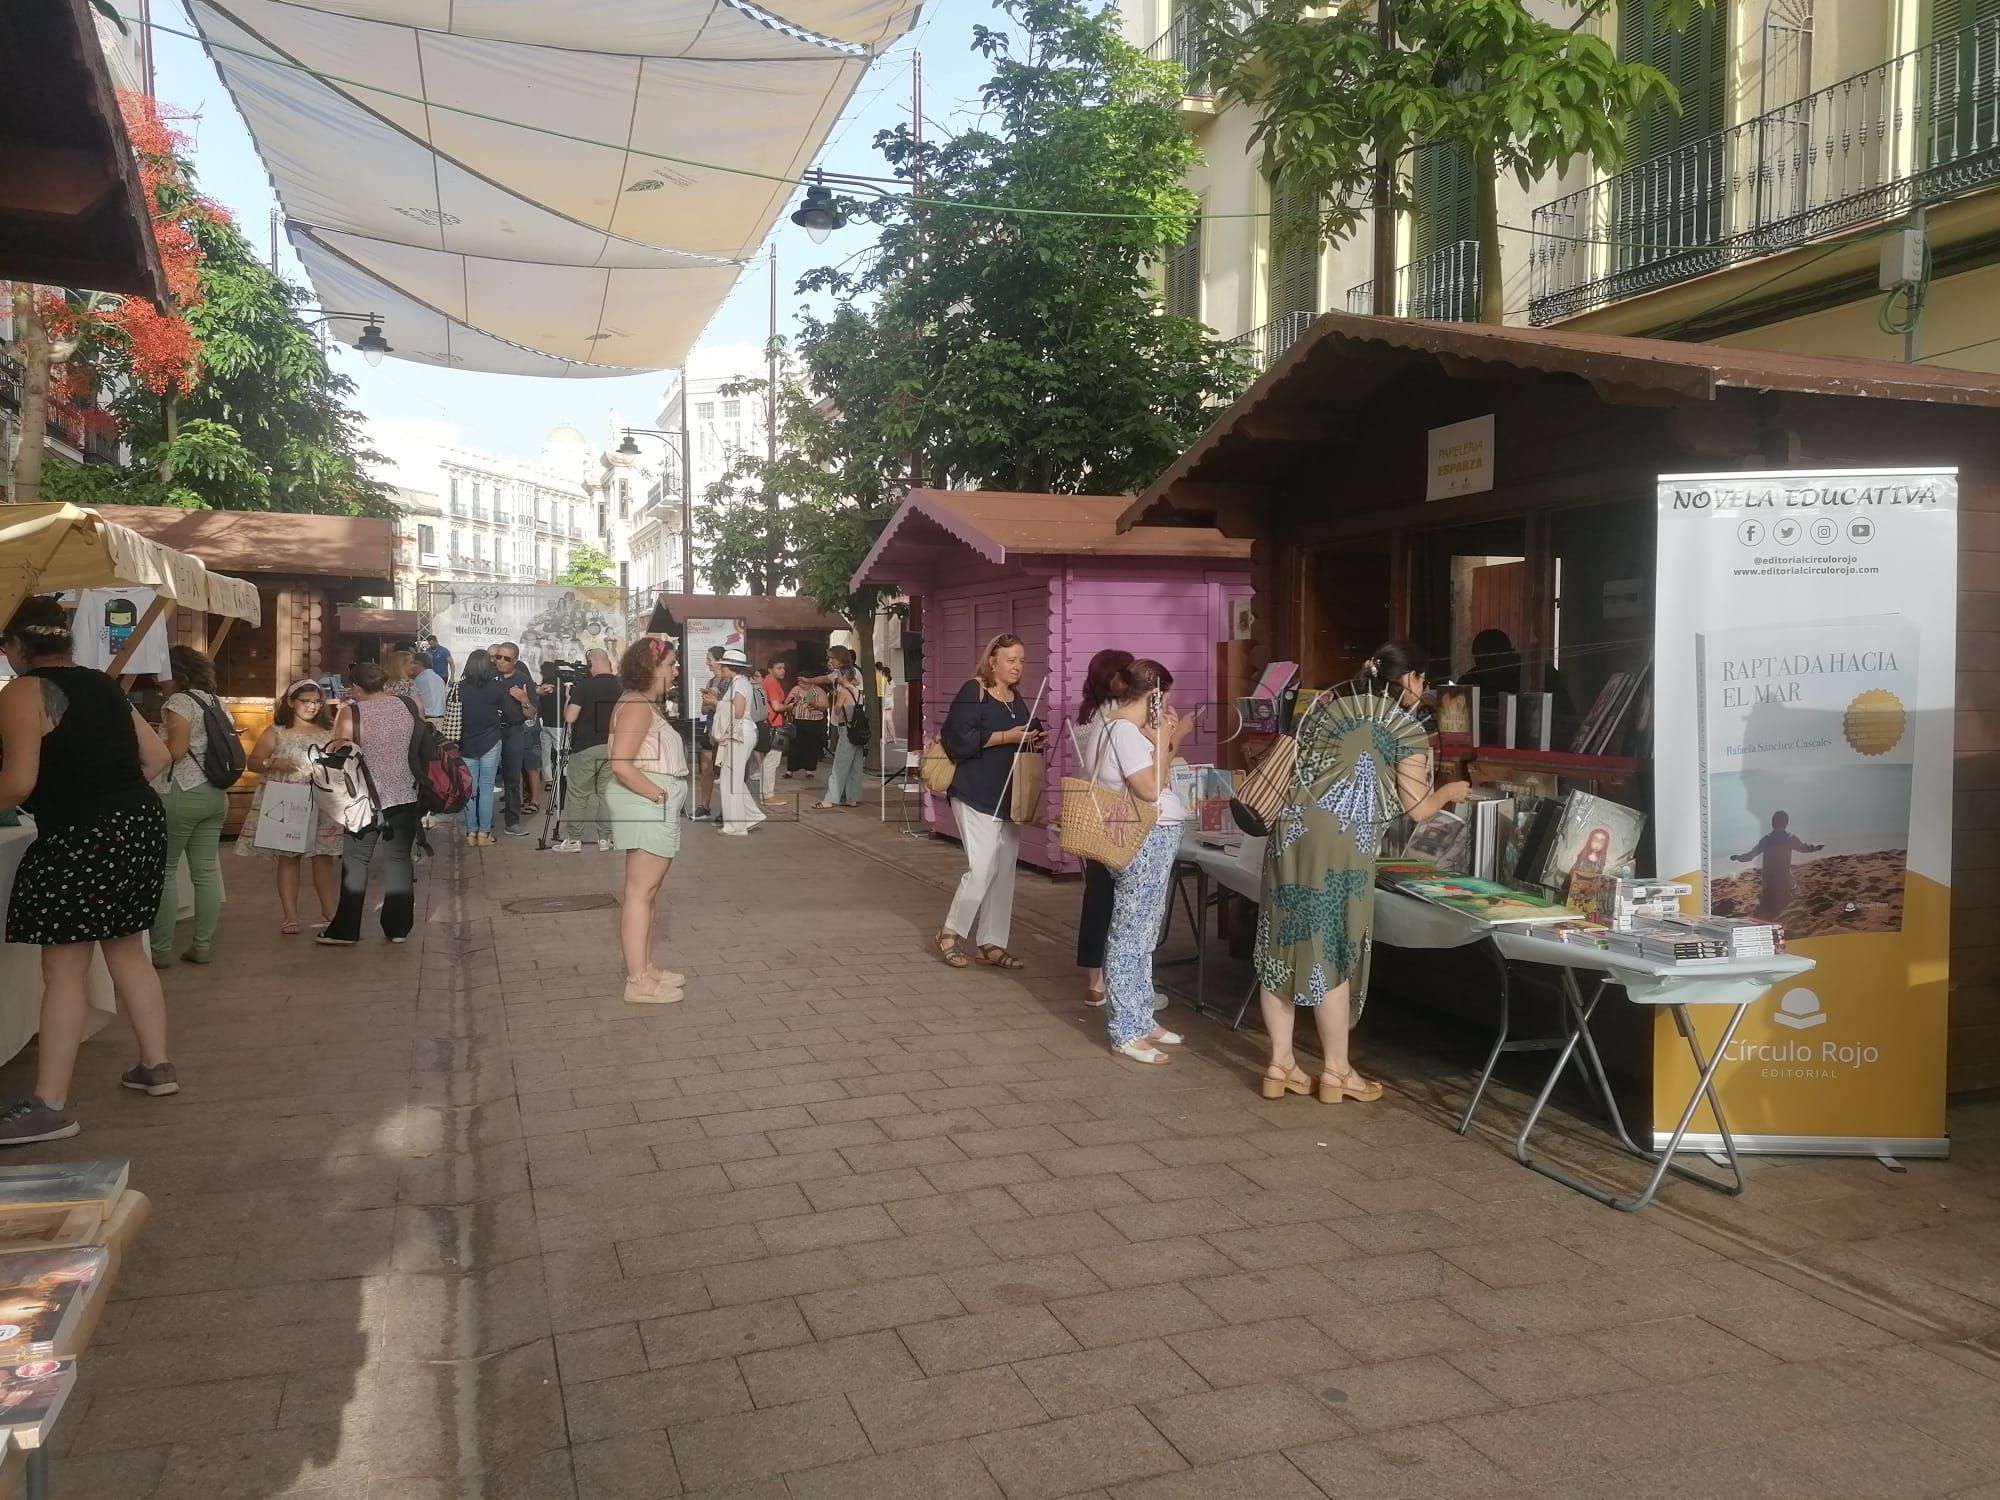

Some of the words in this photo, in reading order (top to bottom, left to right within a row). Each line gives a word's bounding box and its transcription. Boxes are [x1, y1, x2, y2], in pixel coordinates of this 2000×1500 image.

[1672, 488, 1774, 510] NOVELA
[1784, 484, 1937, 508] EDUCATIVA
[1753, 554, 1858, 566] @editorialcirculorojo
[1733, 565, 1880, 577] www.editorialcirculorojo.com
[480, 585, 500, 600] 35
[483, 626, 510, 637] 2022
[1721, 653, 1826, 682] RAPTADA
[1829, 650, 1900, 674] HACIA
[1722, 685, 1750, 709] EL
[1753, 681, 1803, 706] MAR
[1726, 742, 1757, 757] Rafaela
[1757, 738, 1794, 753] Sánchez
[1795, 736, 1833, 750] Cascales
[1722, 1039, 1812, 1063] Círculo
[1822, 1041, 1879, 1069] Rojo
[1761, 1068, 1838, 1079] EDITORIAL
